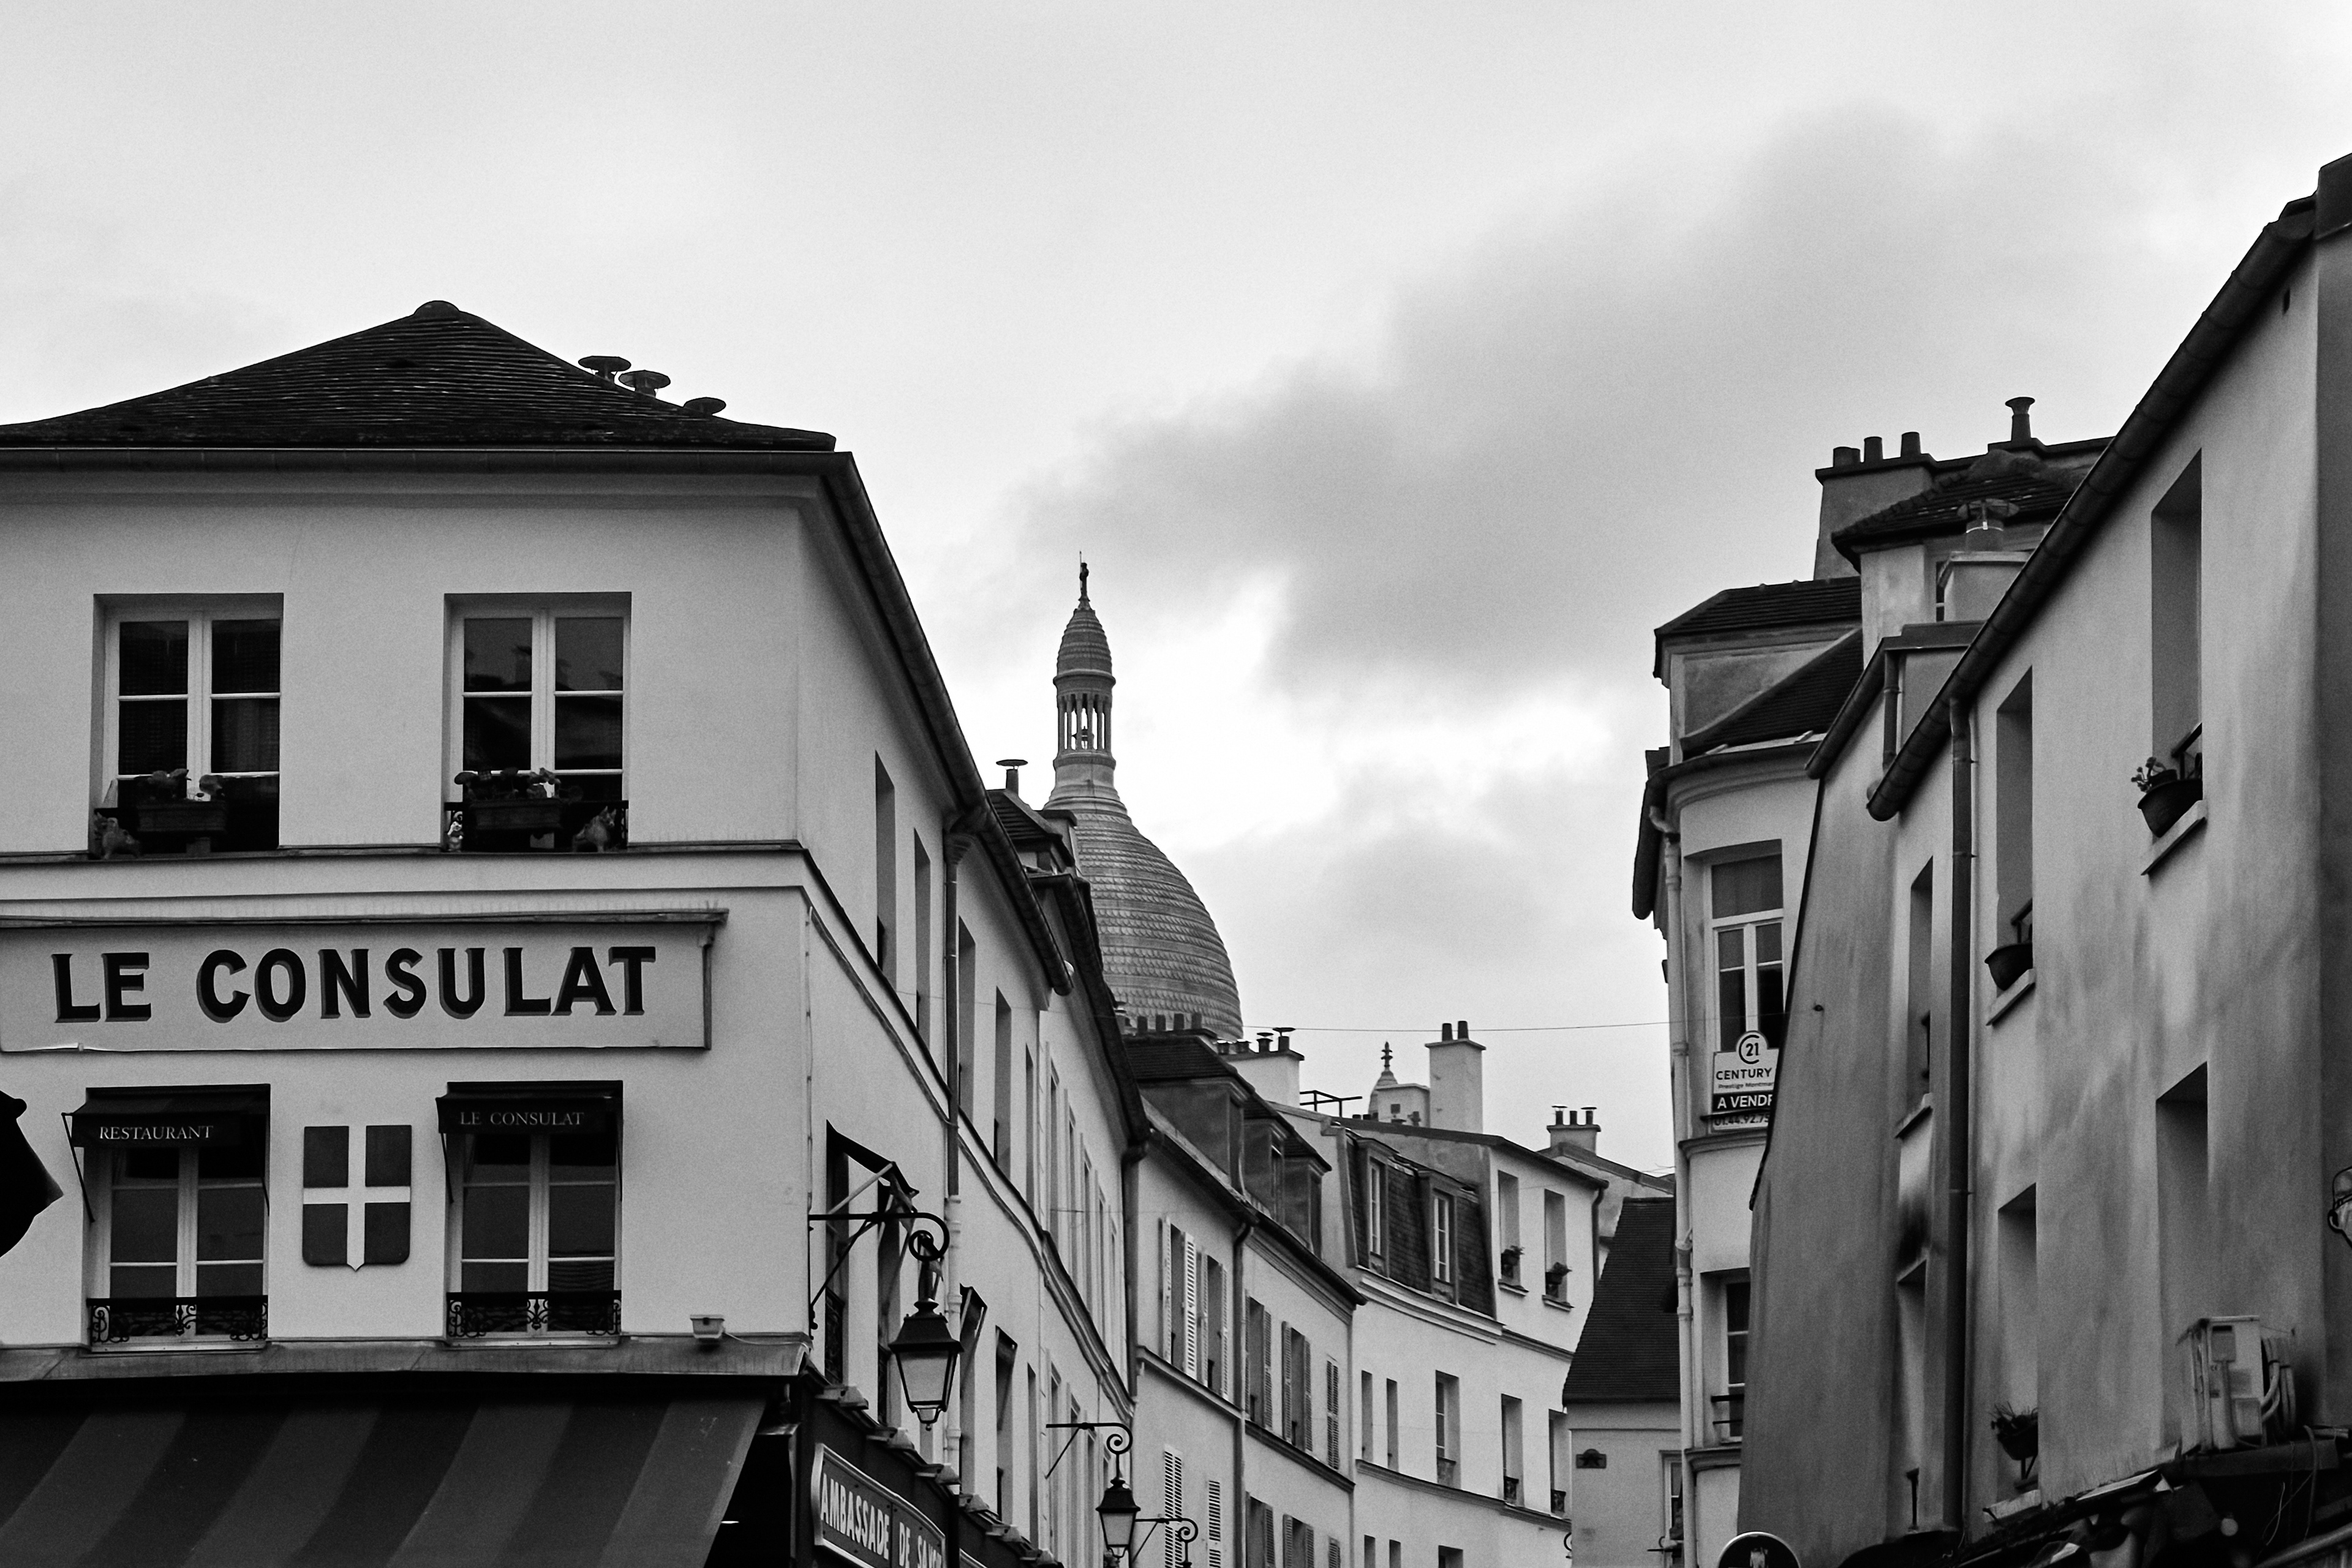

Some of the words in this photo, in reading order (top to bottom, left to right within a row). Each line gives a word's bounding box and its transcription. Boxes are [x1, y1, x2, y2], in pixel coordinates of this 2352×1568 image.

[51, 951, 152, 1023] LE
[196, 946, 656, 1023] CONSULAT
[1746, 1042, 1759, 1057] 21
[1716, 1068, 1772, 1080] CENTURY
[1717, 1096, 1727, 1109] A
[461, 1111, 481, 1125] LE
[490, 1111, 584, 1126] CONSULAT
[99, 1125, 214, 1140] RESTAURANT
[821, 1472, 889, 1561] AMBASSADE
[899, 1521, 911, 1568] DE
